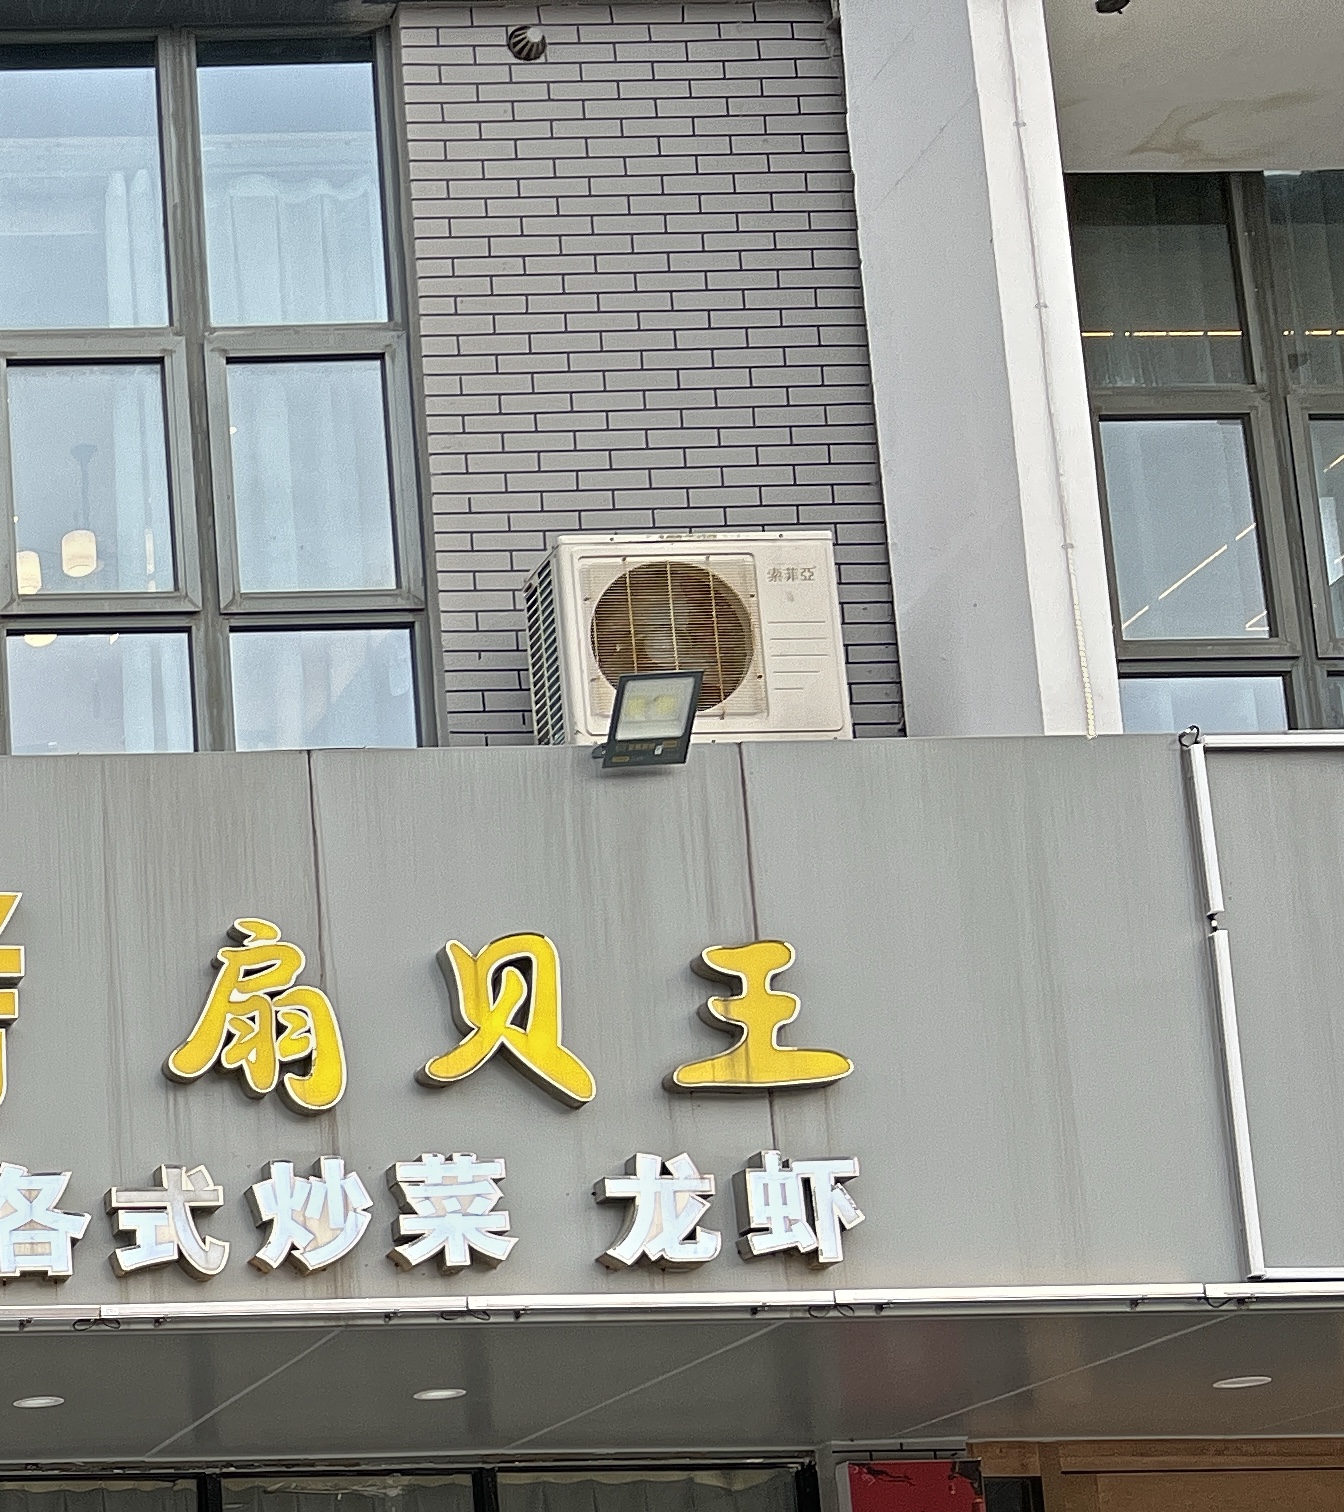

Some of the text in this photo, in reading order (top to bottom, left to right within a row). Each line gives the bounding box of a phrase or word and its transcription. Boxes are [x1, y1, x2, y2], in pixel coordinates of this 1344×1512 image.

[165, 916, 856, 1116] 扇贝王
[594, 1148, 868, 1271] 龙虾
